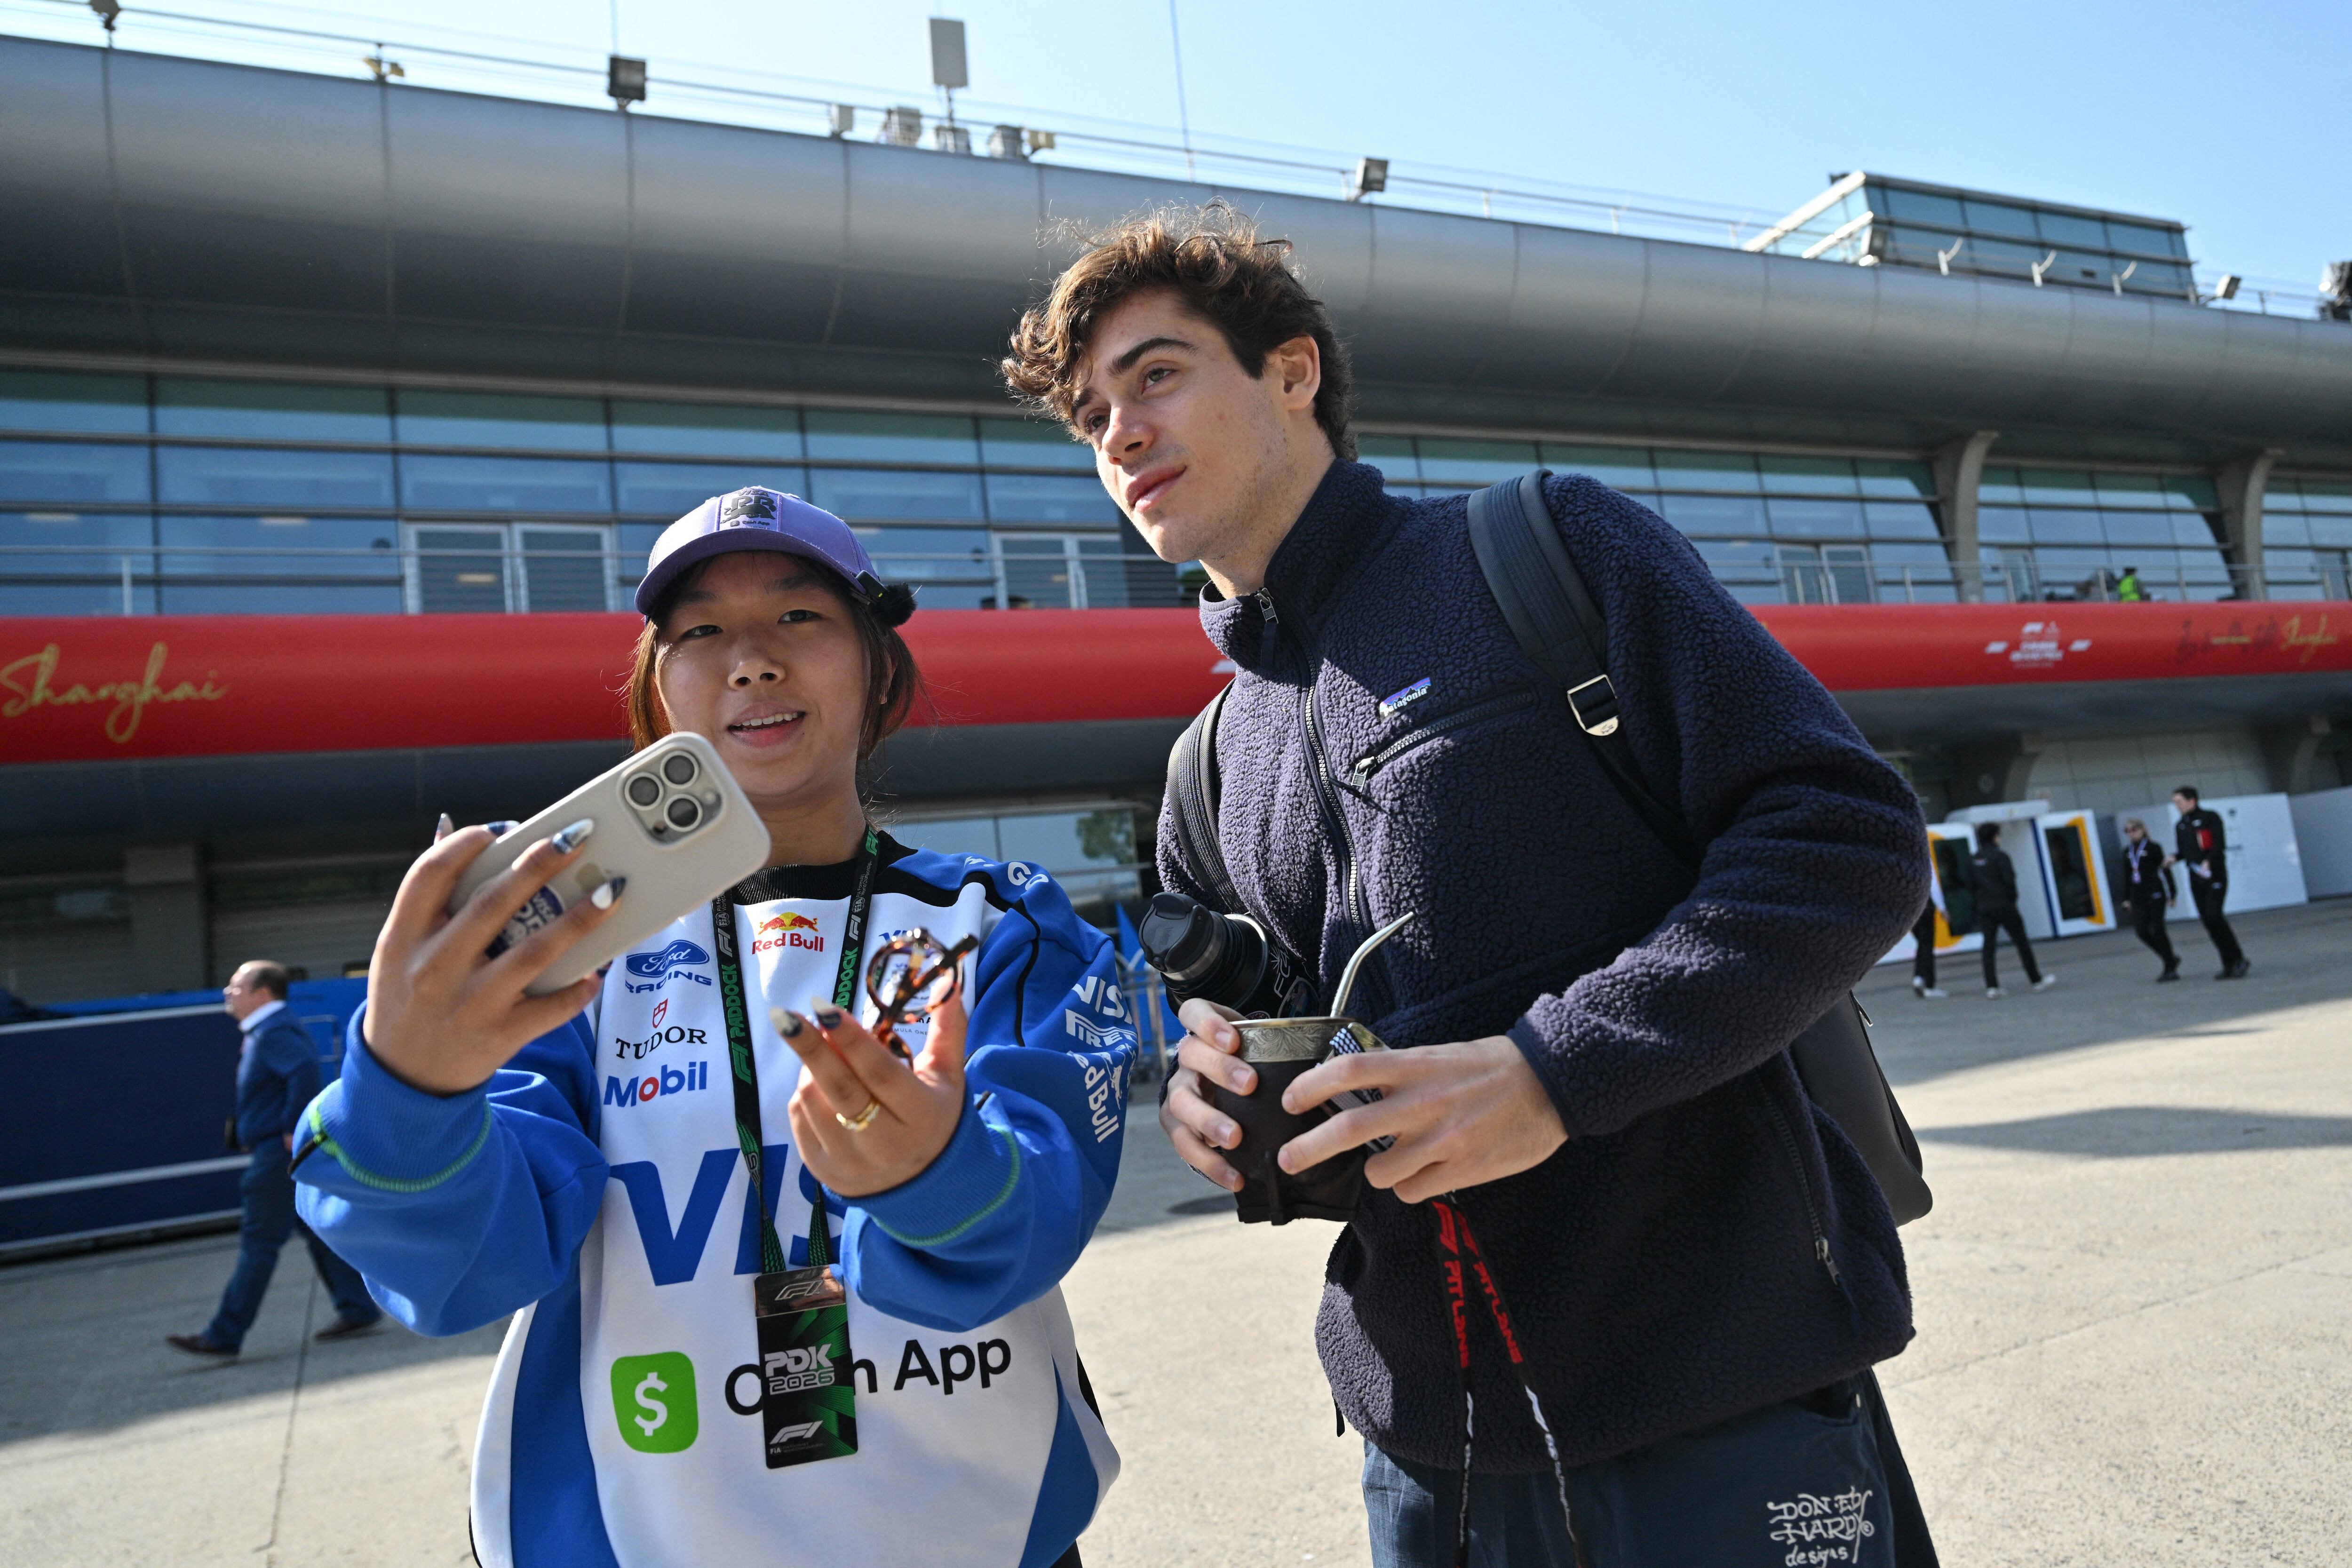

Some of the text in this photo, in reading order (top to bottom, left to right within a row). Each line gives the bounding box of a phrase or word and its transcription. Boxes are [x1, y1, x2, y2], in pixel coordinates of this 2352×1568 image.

[0, 641, 230, 743] Shanghai
[1383, 688, 1428, 717] patagonia
[642, 945, 691, 972] Ford
[752, 933, 824, 955] Red Bull
[625, 971, 712, 994] RACING
[722, 964, 746, 1038] PADDOCK
[616, 1026, 707, 1059] TUDOR
[603, 1061, 707, 1107] Mobil
[1089, 1080, 1119, 1143] Bull
[764, 1343, 834, 1377] PDK
[725, 1357, 878, 1416] Ch
[894, 1338, 1011, 1395] App
[769, 1367, 835, 1395] 2026
[1767, 1493, 1832, 1524] DON
[1785, 1545, 1849, 1568] designs
